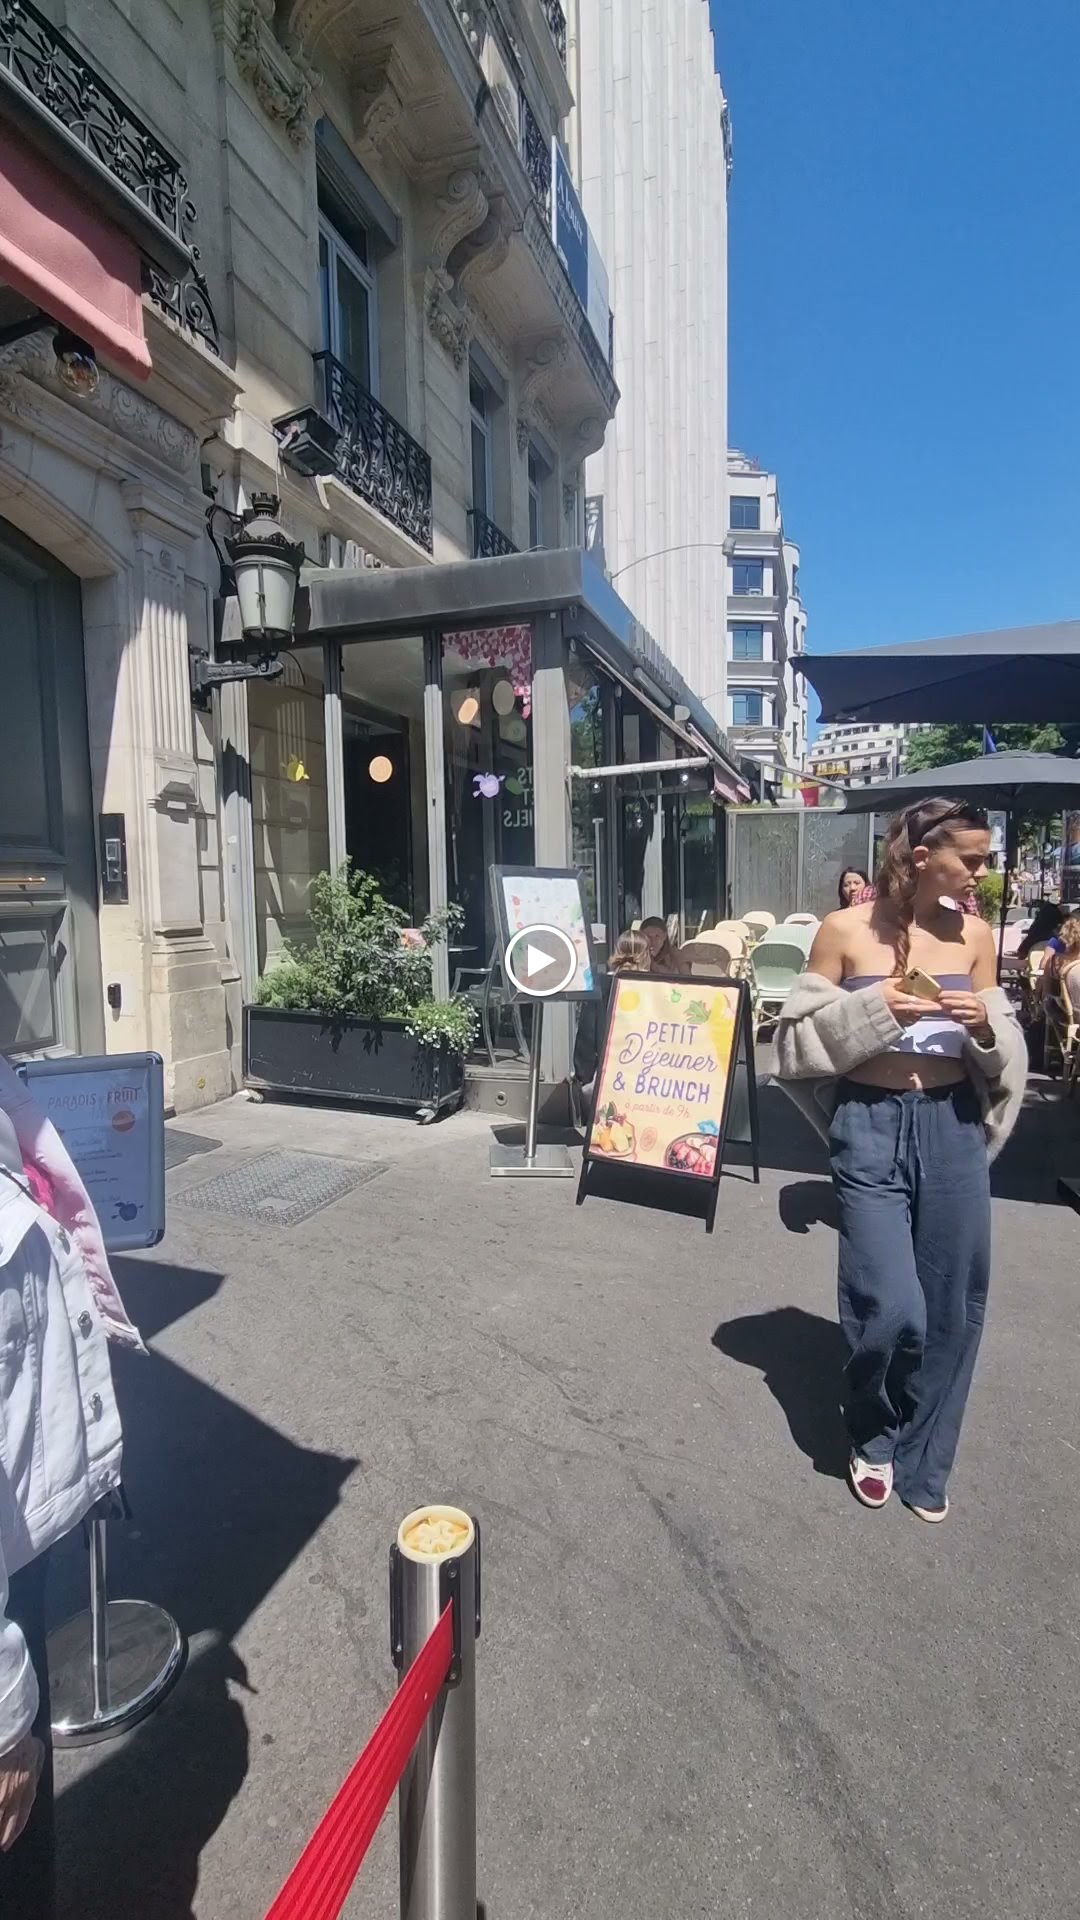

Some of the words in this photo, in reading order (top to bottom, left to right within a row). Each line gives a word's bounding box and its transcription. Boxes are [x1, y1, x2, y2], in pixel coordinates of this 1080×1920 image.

[646, 1021, 698, 1045] PETIT
[619, 1032, 718, 1075] Déjeuner
[47, 1092, 97, 1112] PARADIS
[107, 1086, 142, 1104] FRUIT
[612, 1071, 626, 1091] &
[634, 1073, 711, 1104] BRUNCH
